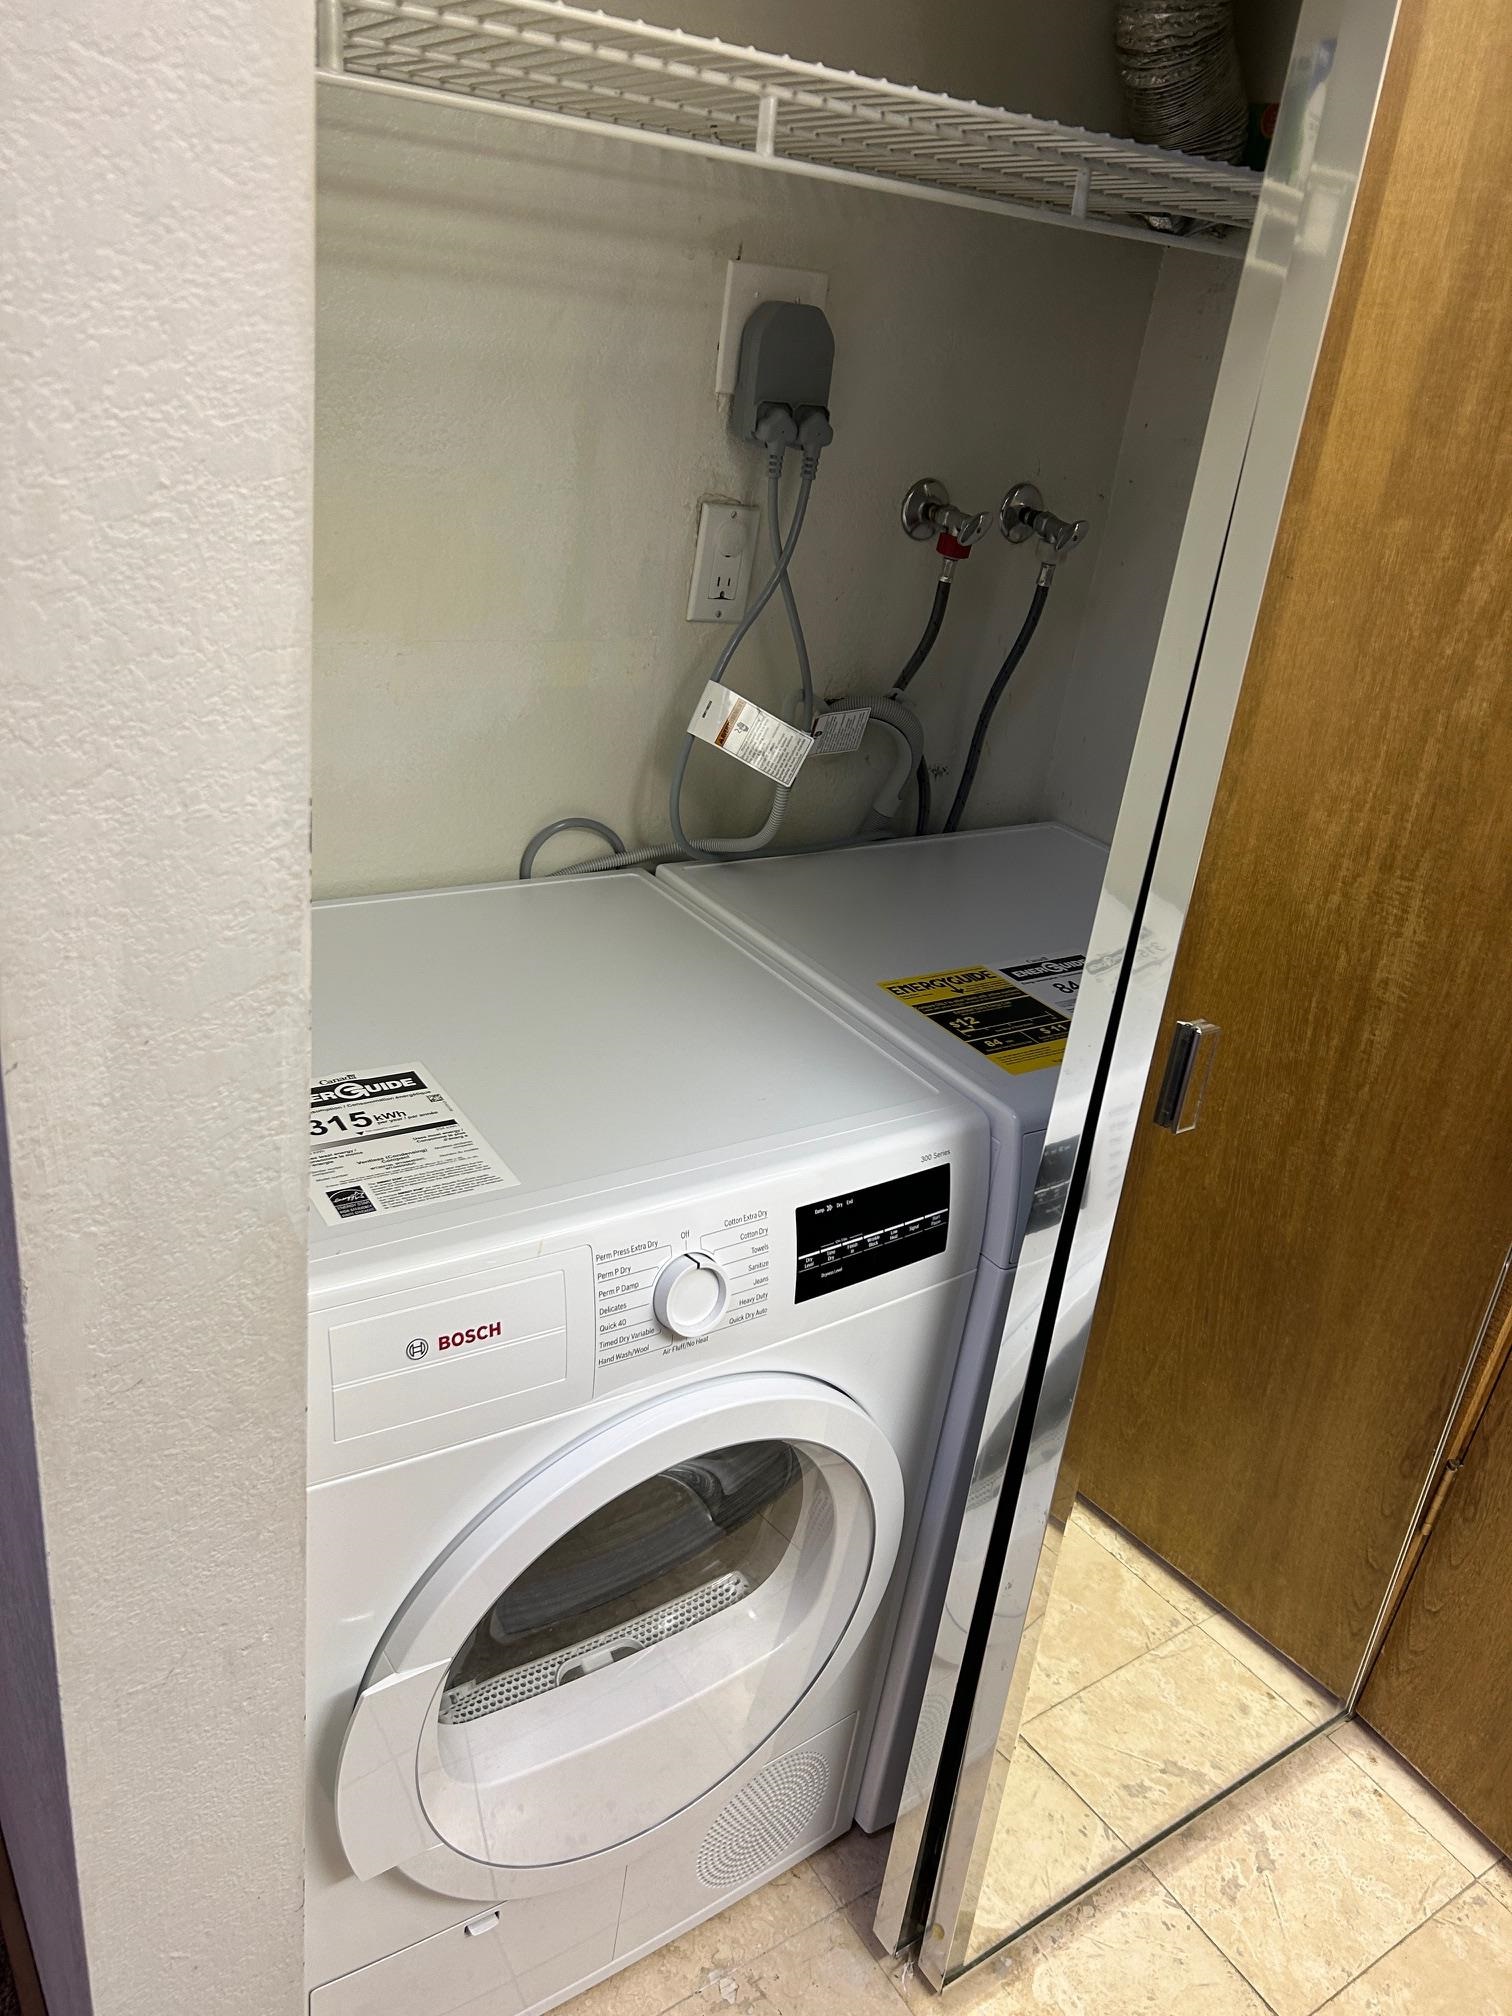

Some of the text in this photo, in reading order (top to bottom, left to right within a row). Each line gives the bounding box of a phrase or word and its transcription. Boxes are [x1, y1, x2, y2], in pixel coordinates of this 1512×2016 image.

[886, 970, 997, 996] ENERGYGUIDE
[310, 1111, 372, 1136] 315
[373, 1110, 407, 1121] kWh
[724, 1209, 768, 1227] Cotton Extra Dry
[680, 1230, 690, 1239] Off
[740, 1227, 768, 1240] Cotton Dry
[596, 1240, 658, 1262] Perm Press Extra Dry
[751, 1243, 769, 1254] Towels
[598, 1271, 614, 1280] Perm
[620, 1265, 631, 1276] Dry
[748, 1260, 769, 1272] Sanitize
[753, 1276, 769, 1286] Jeans
[599, 1288, 615, 1298] Perm
[621, 1282, 639, 1293] Damp
[739, 1292, 768, 1306] Heavy Duty
[599, 1302, 627, 1315] Delicates
[729, 1307, 768, 1325] Quick Dry Auto
[600, 1320, 617, 1332] Quick
[439, 1321, 501, 1351] BOSCH
[599, 1327, 655, 1349] Timed Dry Variable
[663, 1336, 708, 1356] Air Fluff/No Heat
[599, 1344, 649, 1366] Hand Wash/Wool
